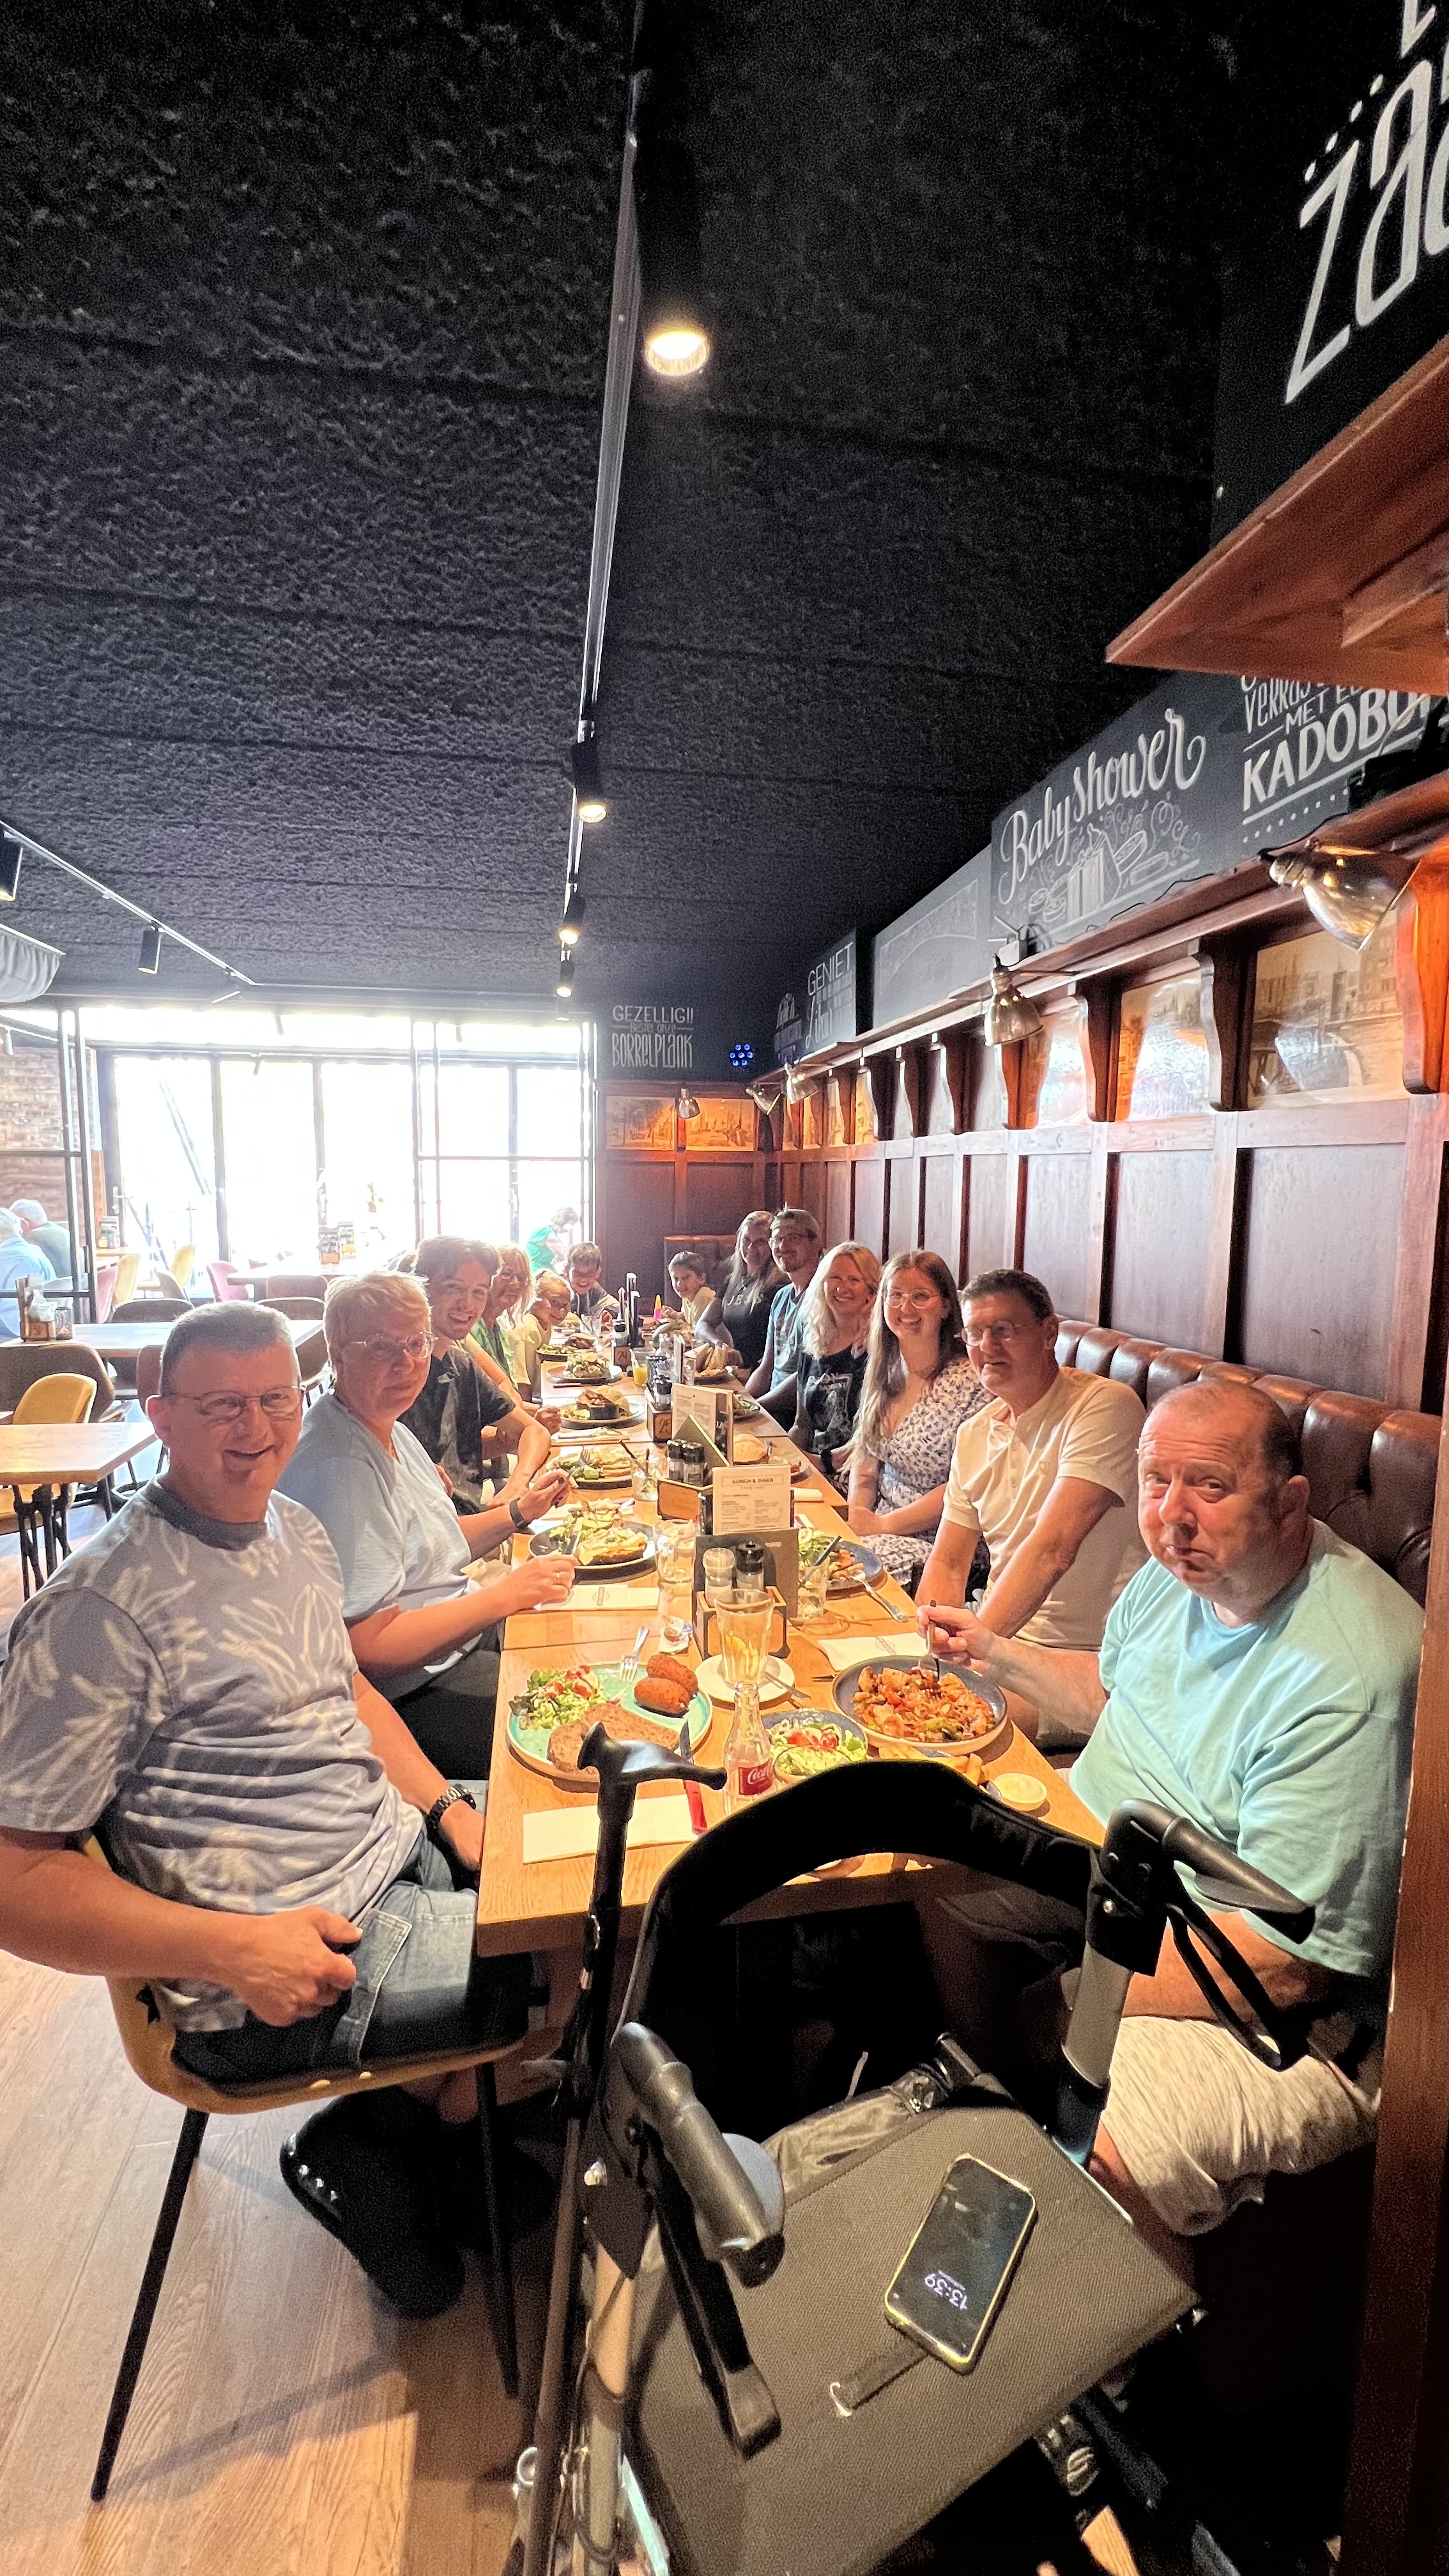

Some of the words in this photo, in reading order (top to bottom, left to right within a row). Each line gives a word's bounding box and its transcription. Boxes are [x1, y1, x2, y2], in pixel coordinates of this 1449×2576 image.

[1285, 689, 1330, 734] MET
[808, 941, 854, 997] GENIET
[924, 2273, 968, 2311] 13:39
